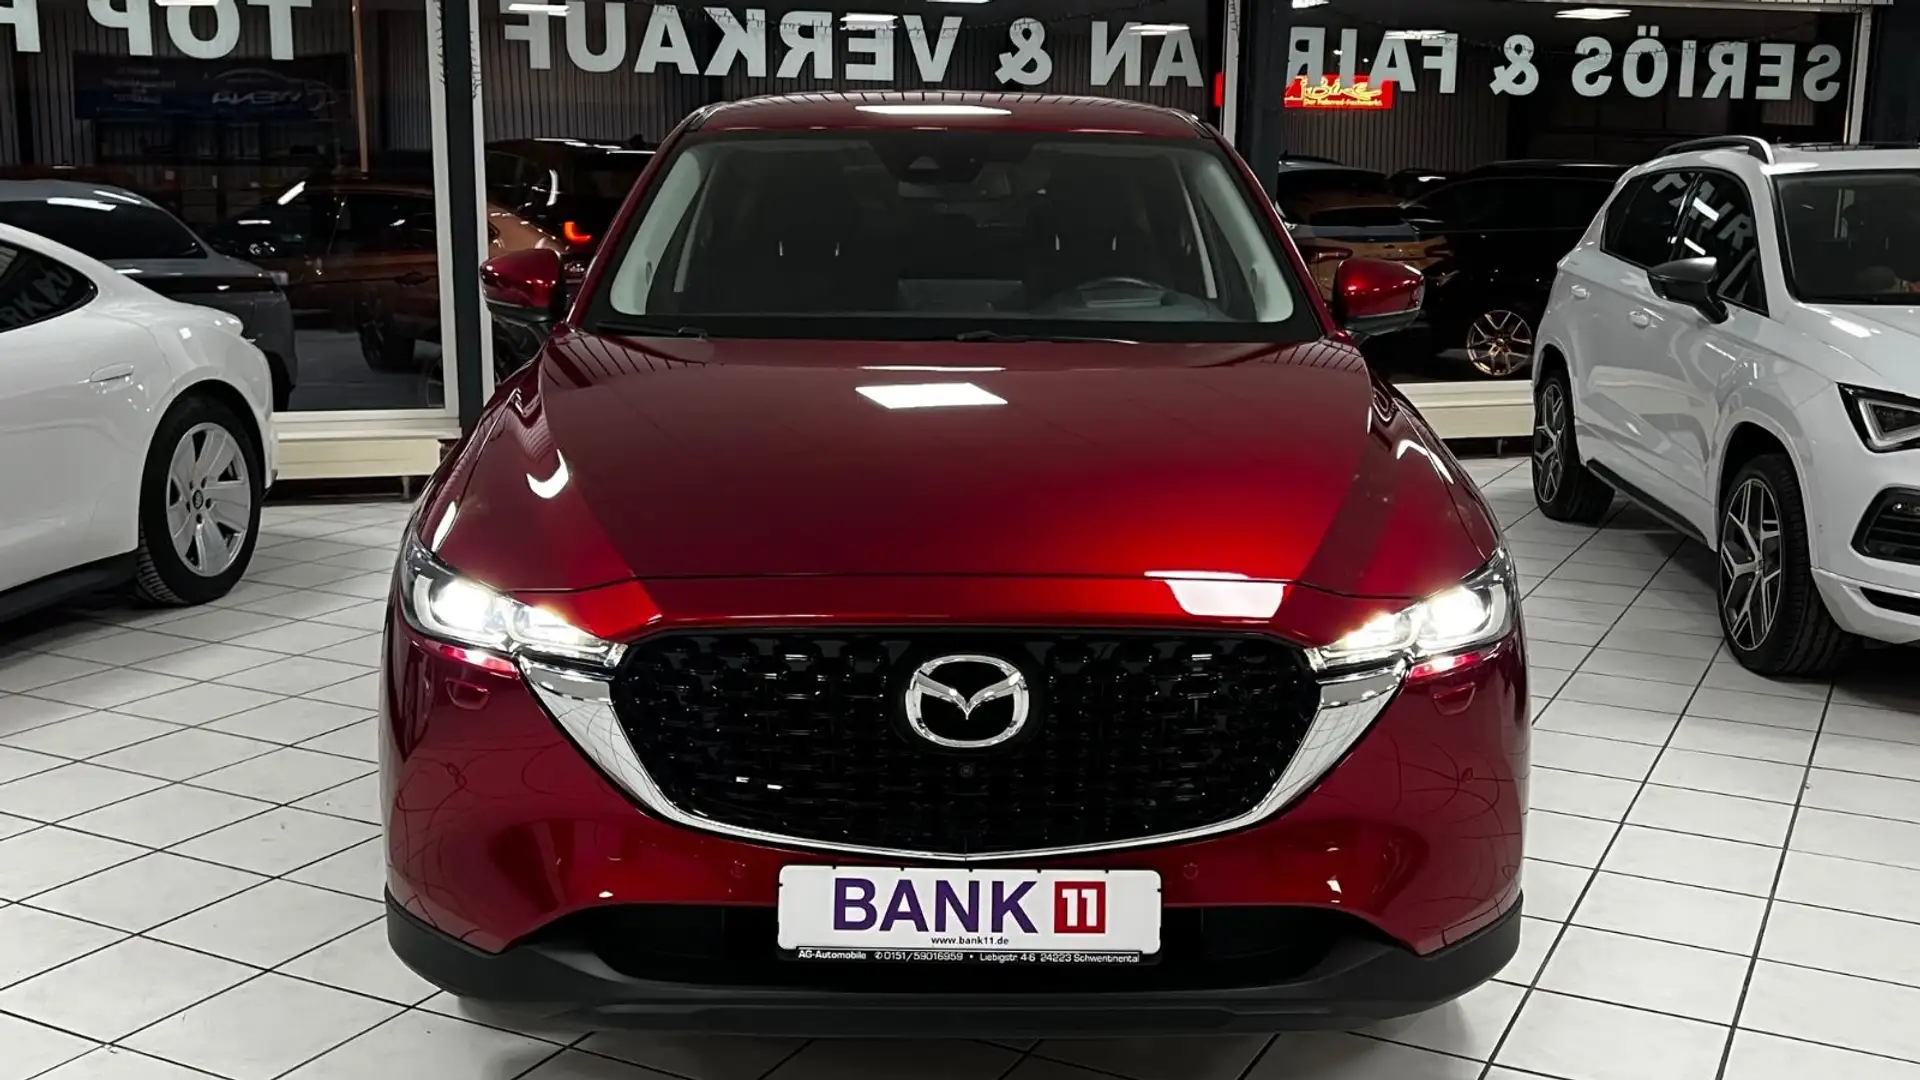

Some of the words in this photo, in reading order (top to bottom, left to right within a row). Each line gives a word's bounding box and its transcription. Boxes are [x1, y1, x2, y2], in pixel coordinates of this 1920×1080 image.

[833, 877, 1038, 933] BANK
[1061, 888, 1098, 927] 11
[931, 936, 1009, 946] www.bank11.de
[798, 950, 867, 960] AG-Automobile
[1039, 953, 1072, 963] 24223
